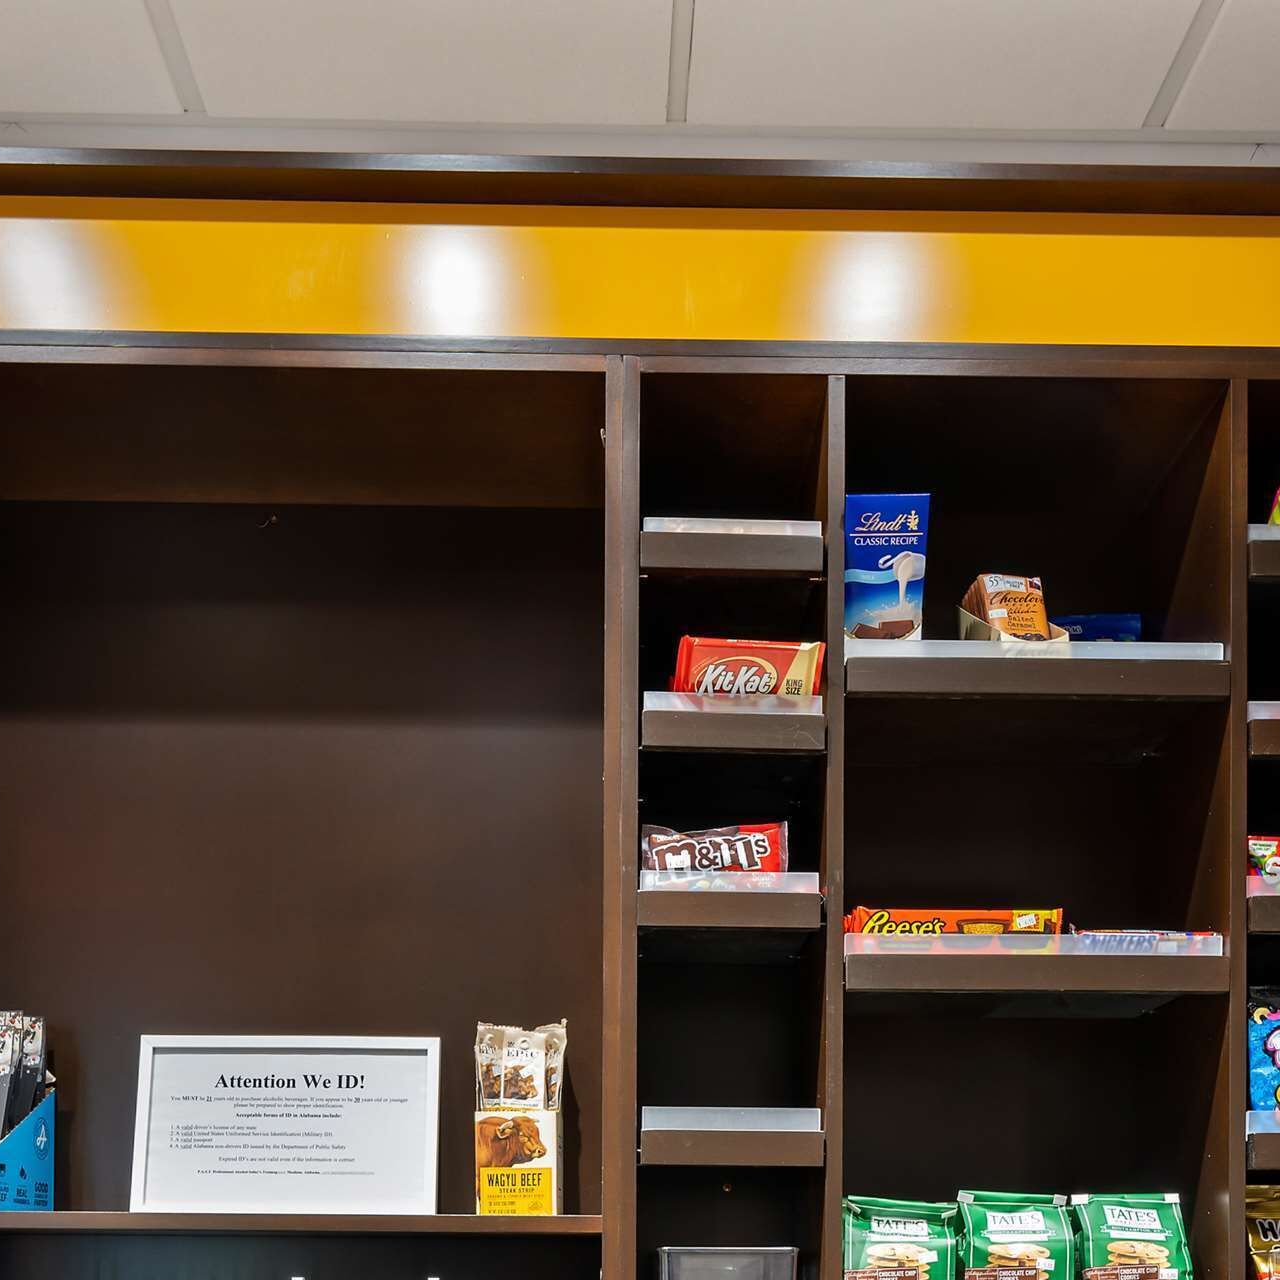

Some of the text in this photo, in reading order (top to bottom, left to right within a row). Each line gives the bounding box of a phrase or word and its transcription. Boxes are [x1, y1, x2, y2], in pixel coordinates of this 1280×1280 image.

[855, 512, 907, 532] Lindt
[854, 536, 919, 546] CLASSIC RECIPE
[697, 663, 773, 697] KitKat
[785, 679, 803, 688] KING
[785, 687, 801, 696] SIZE
[861, 910, 945, 936] Reese's
[214, 1074, 365, 1089] Attention We ID!
[487, 1172, 542, 1187] WAGYU BEEF
[1107, 1207, 1157, 1224] TATE'S
